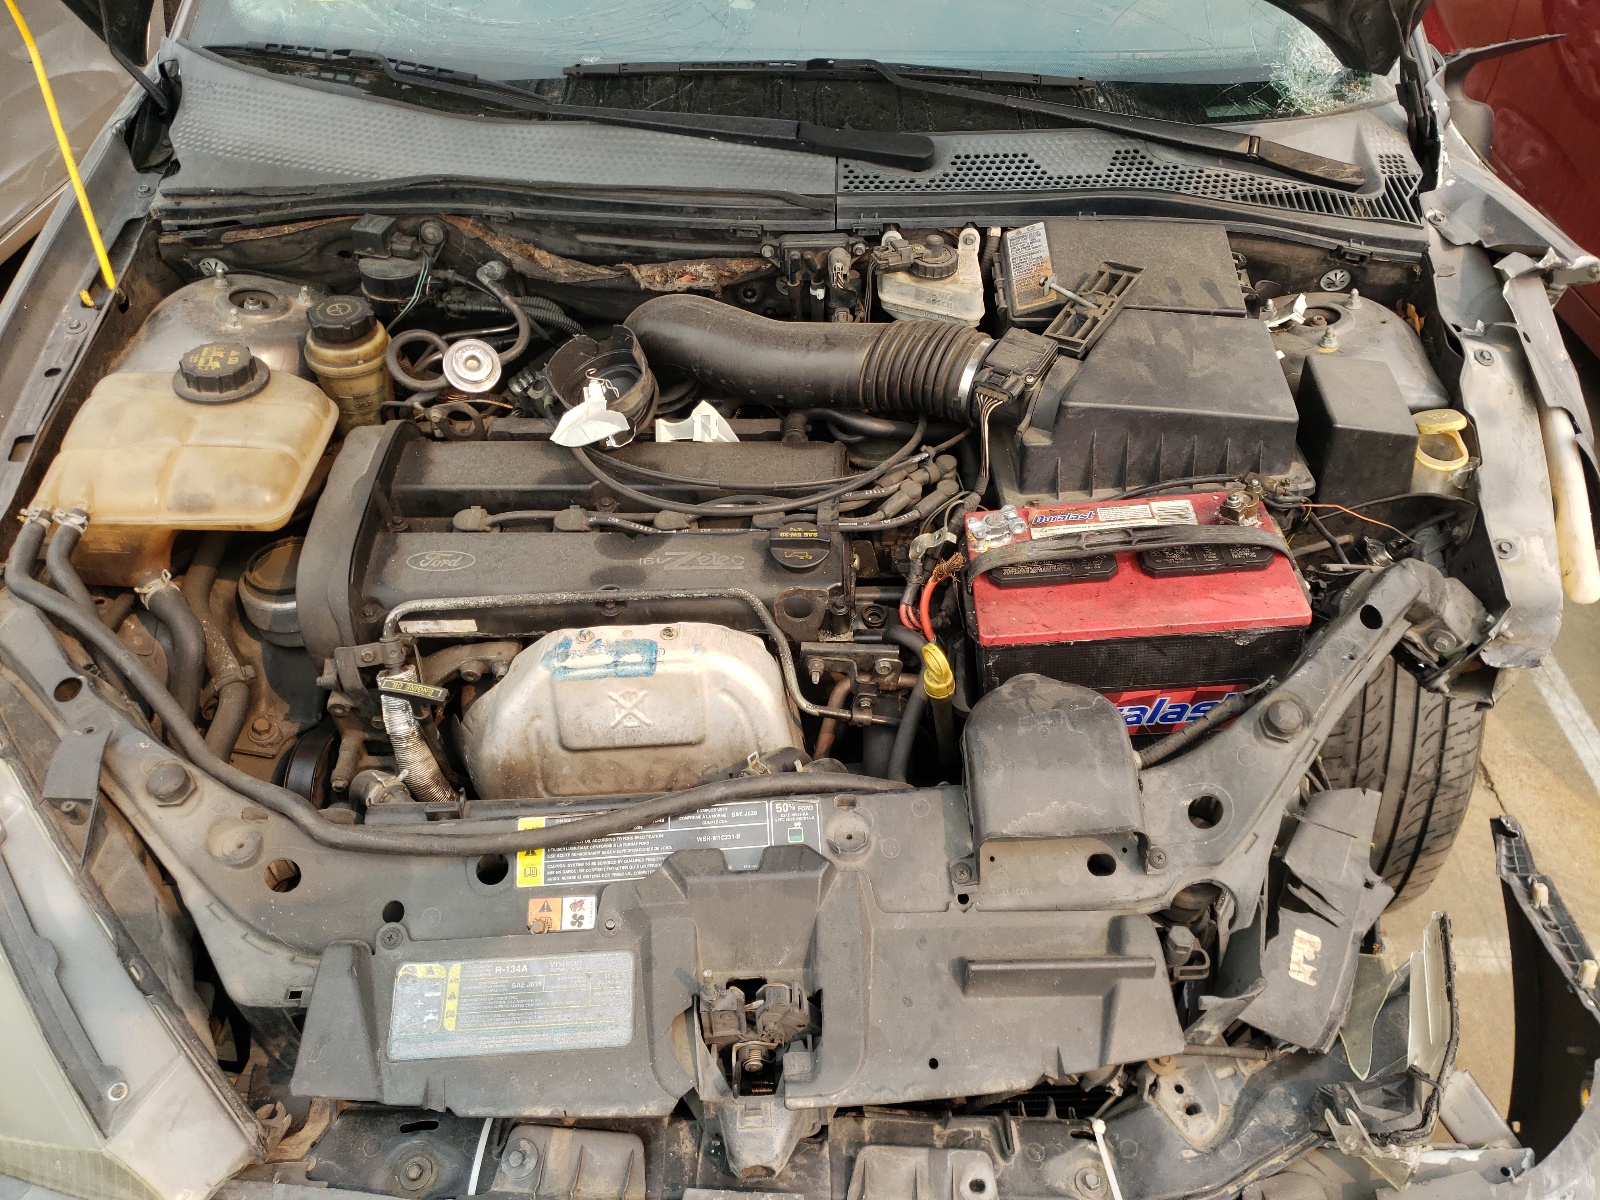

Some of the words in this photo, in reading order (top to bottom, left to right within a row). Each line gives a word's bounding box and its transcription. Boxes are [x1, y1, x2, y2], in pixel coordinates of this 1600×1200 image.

[1032, 511, 1095, 524] Duralast
[419, 553, 463, 568] Ford
[664, 551, 745, 571] Zetec
[391, 682, 404, 690] OIL
[405, 684, 434, 697] ENGINE
[775, 803, 796, 813] 50%
[495, 964, 528, 974] R-134A
